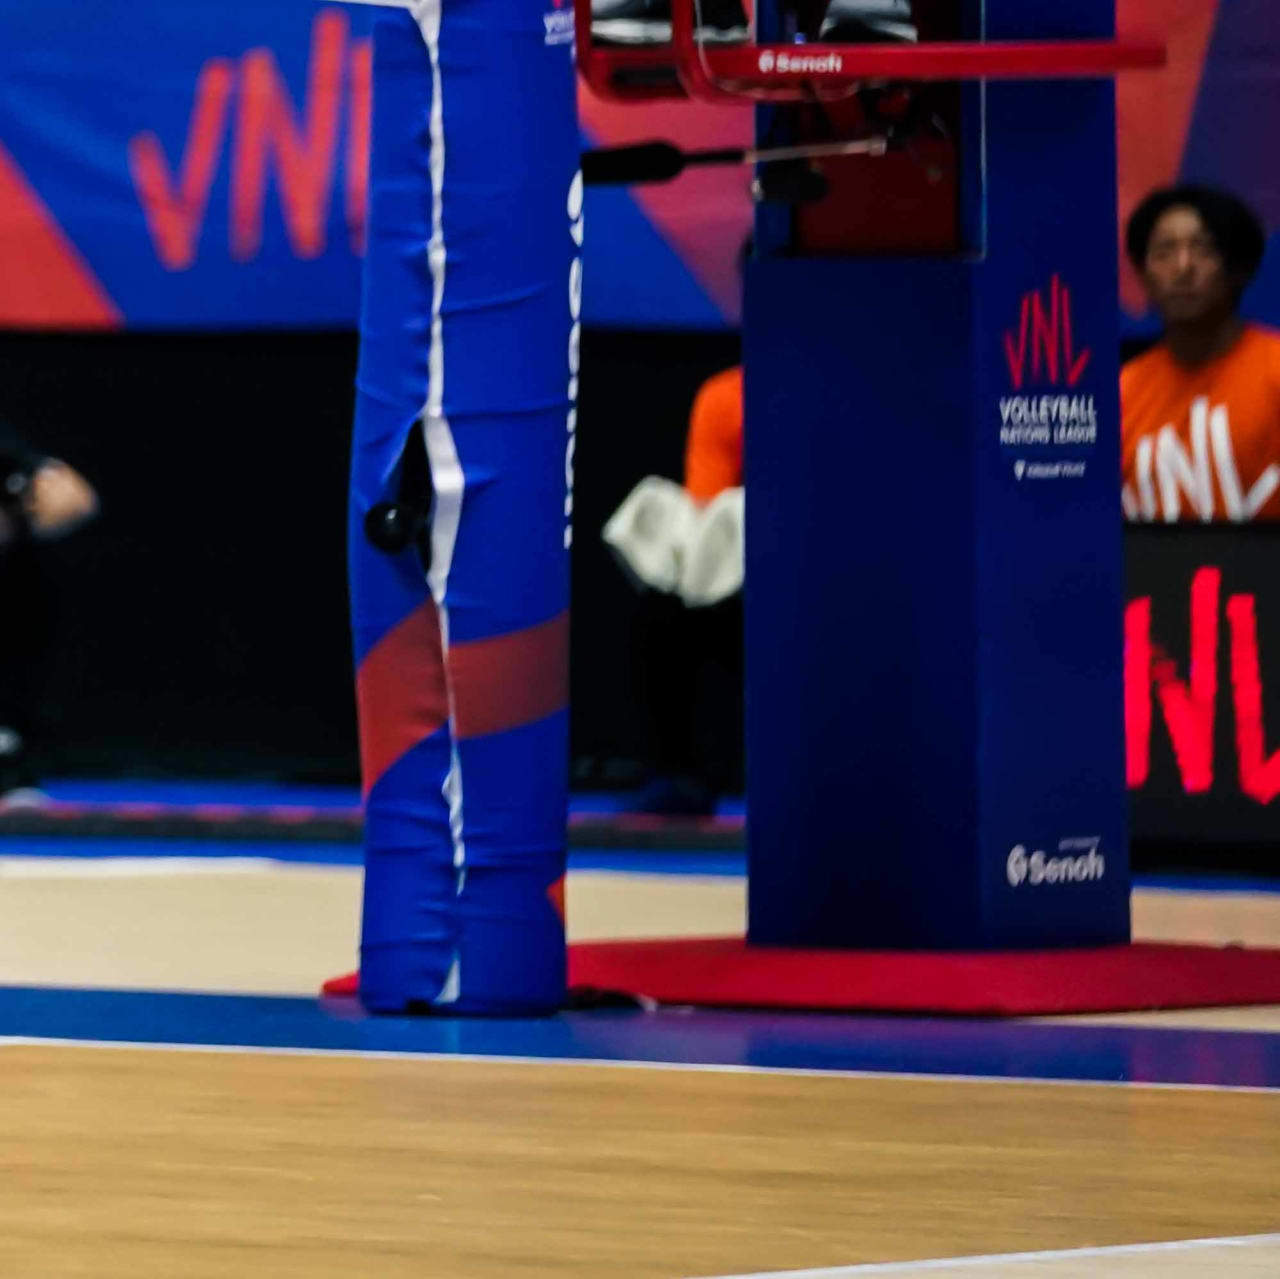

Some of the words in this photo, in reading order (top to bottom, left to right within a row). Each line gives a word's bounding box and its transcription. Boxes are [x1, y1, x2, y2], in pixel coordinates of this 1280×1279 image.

[1004, 273, 1091, 390] VNL
[1000, 395, 1097, 424] VOLLEYBALL
[1124, 567, 1280, 805] NL
